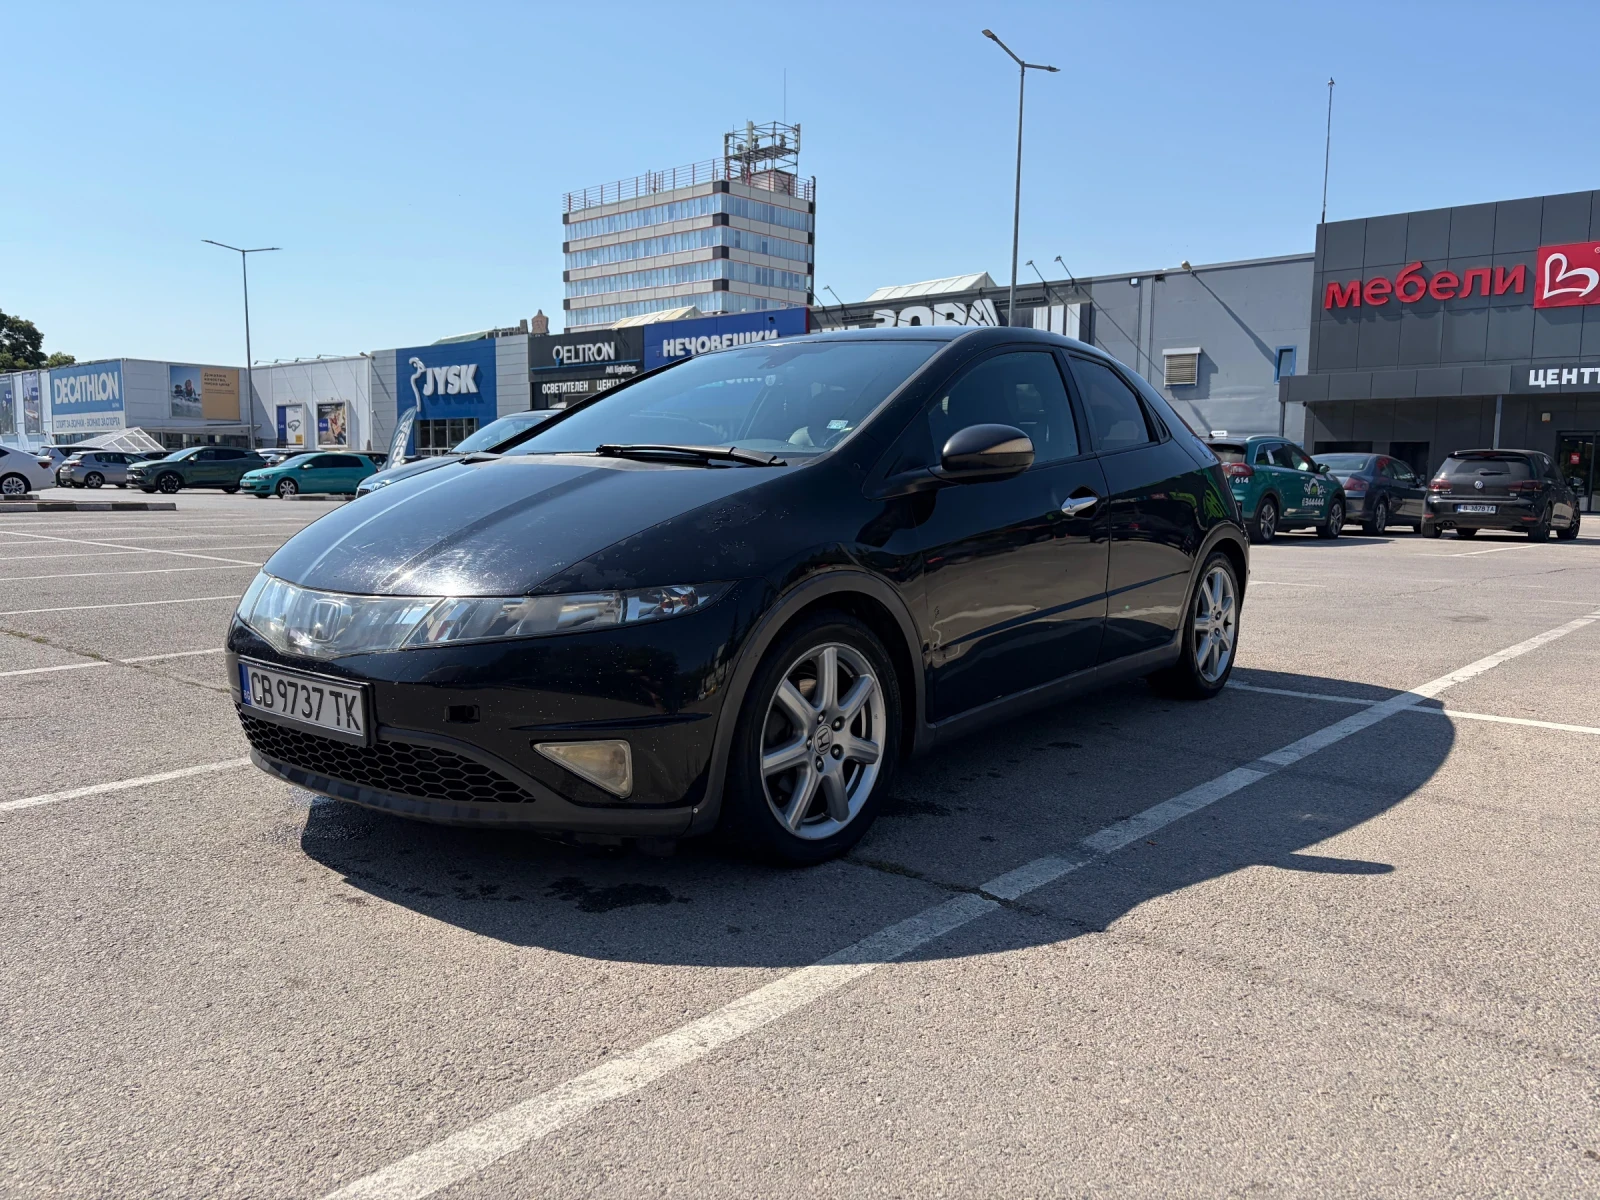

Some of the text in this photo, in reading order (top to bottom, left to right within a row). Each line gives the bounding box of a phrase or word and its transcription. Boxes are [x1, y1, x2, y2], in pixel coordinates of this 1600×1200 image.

[1324, 261, 1526, 310] мебели
[54, 371, 119, 405] DECATHLON
[423, 364, 479, 396] JYSK
[542, 381, 589, 395] ОСВЕТИТЕЛЕН
[1235, 476, 1249, 484] 614
[251, 672, 361, 731] CB 9737 TK
